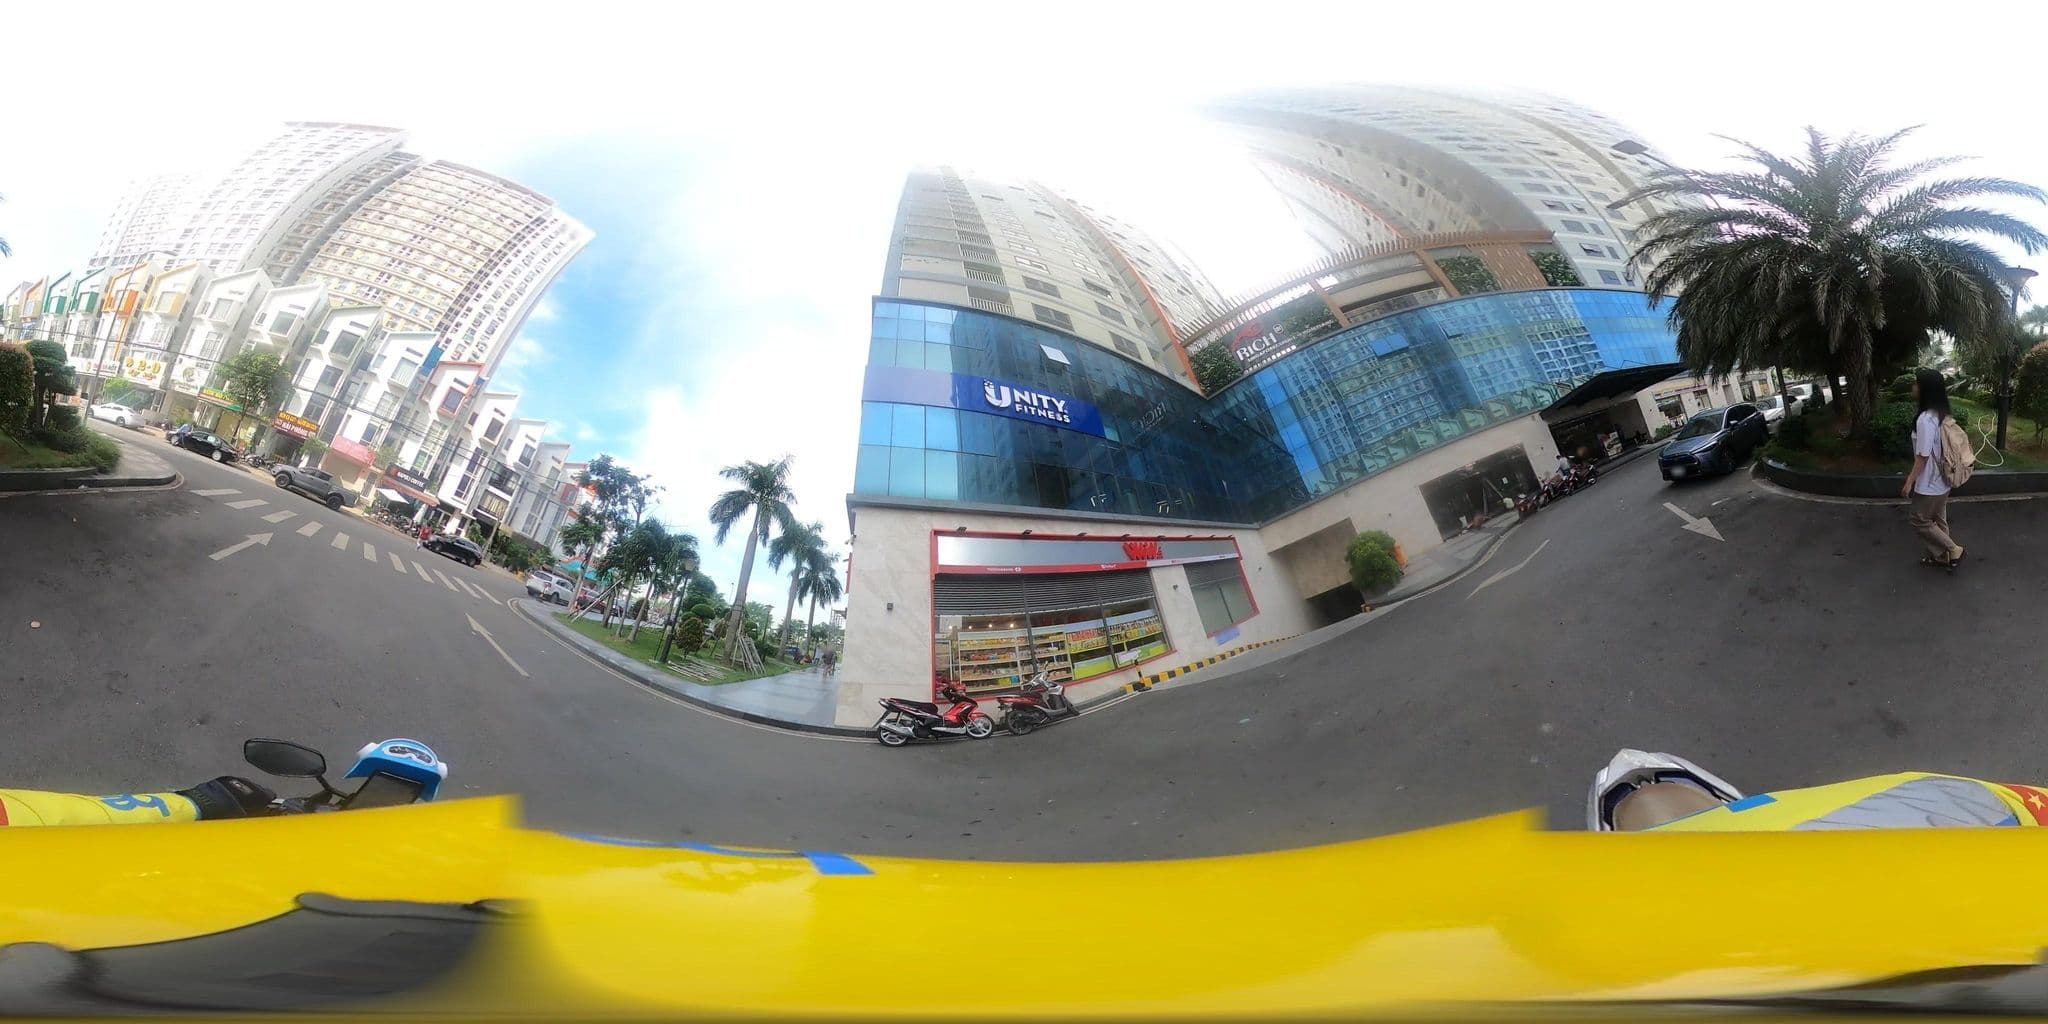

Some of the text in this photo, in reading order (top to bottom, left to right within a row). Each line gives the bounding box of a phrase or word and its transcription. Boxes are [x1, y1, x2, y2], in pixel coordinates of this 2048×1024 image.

[1236, 332, 1277, 361] RICH
[983, 379, 1066, 413] UNITY
[1015, 403, 1071, 424] FITNESS
